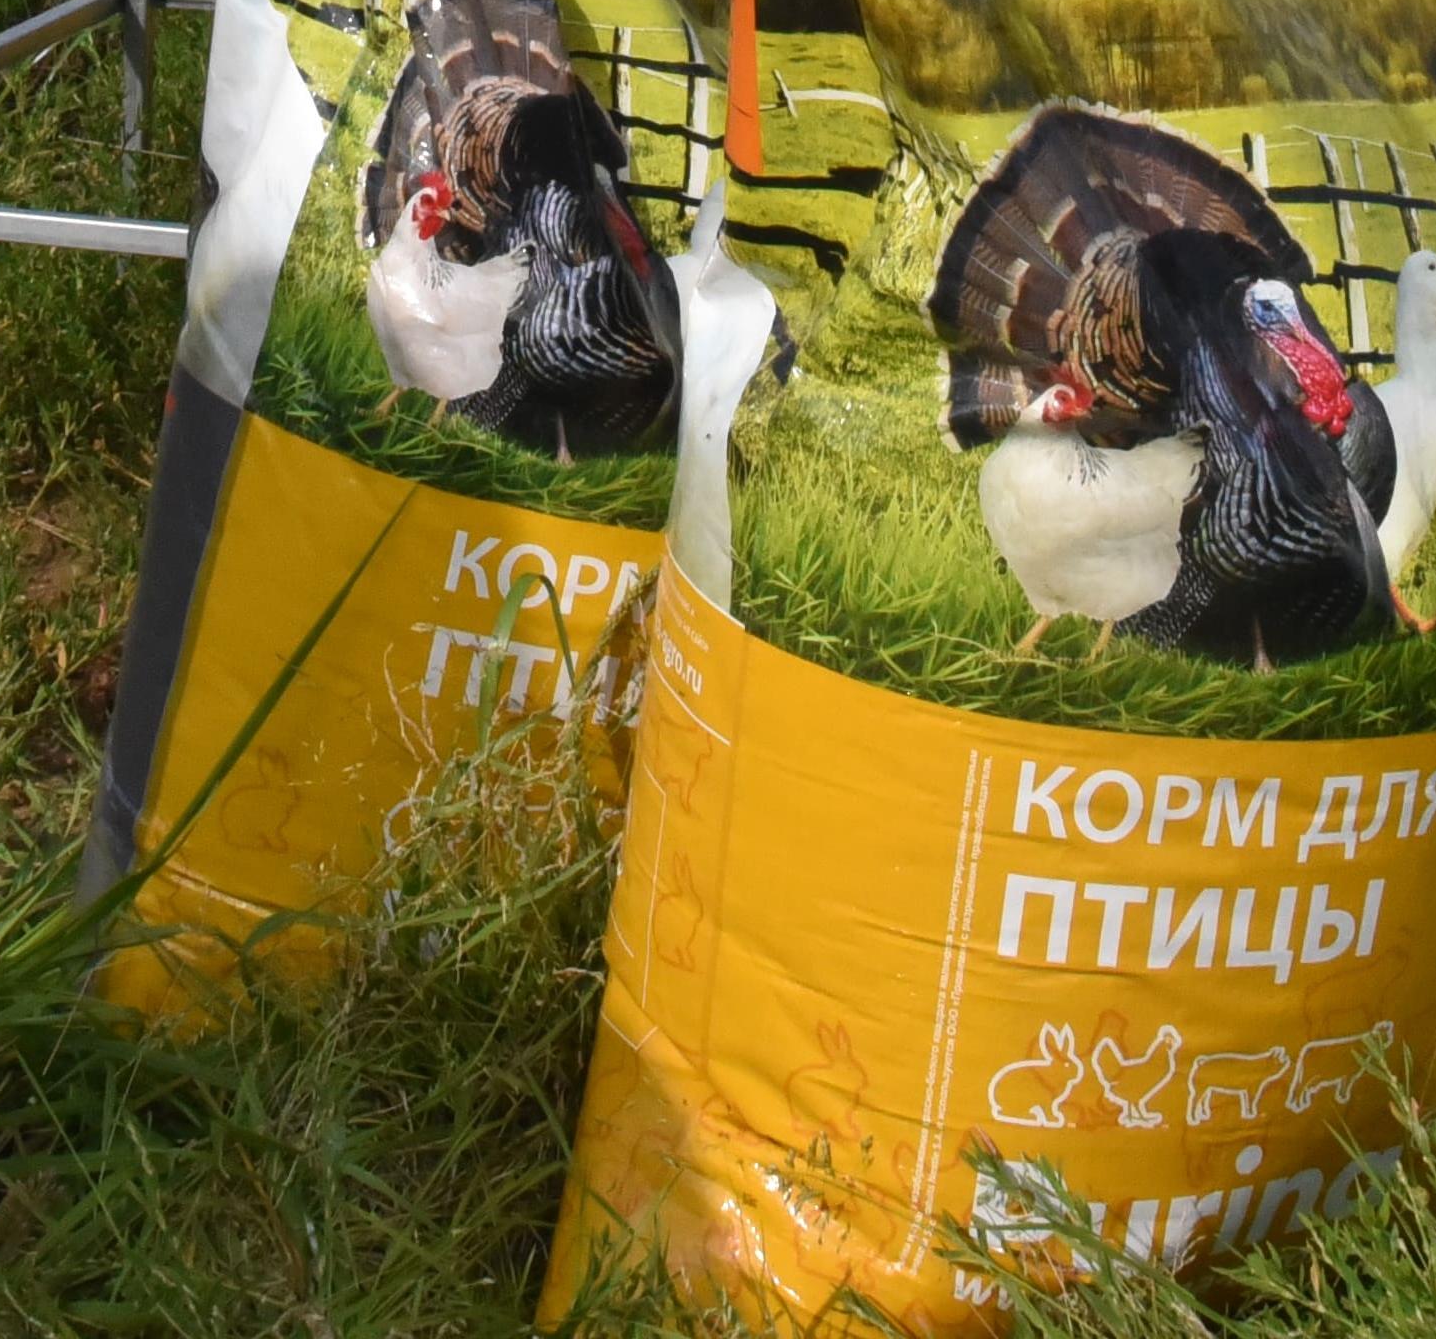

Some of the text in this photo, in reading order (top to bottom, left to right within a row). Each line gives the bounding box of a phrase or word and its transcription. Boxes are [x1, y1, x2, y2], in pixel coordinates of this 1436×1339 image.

[1012, 760, 1281, 848] КОРМ
[997, 873, 1385, 985] ПТИЦЫ
[947, 1008, 957, 1036] ООО
[970, 1145, 1402, 1276] Purina
